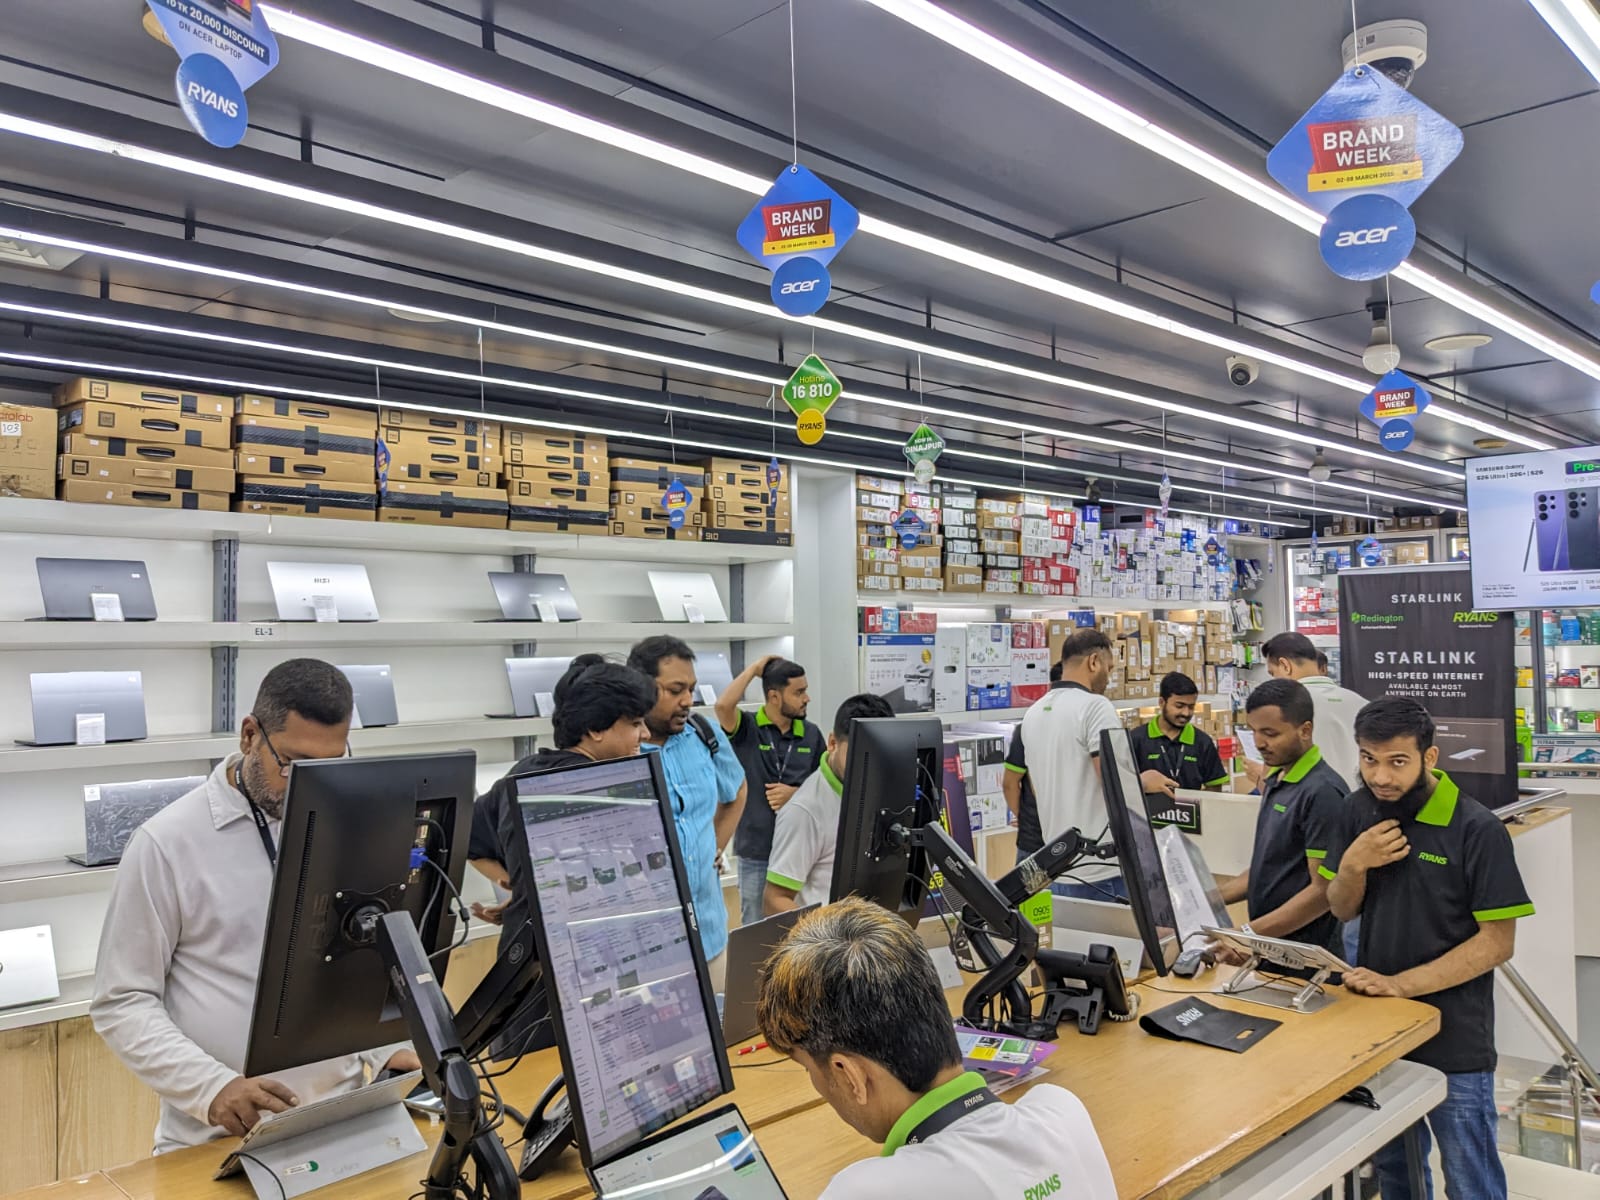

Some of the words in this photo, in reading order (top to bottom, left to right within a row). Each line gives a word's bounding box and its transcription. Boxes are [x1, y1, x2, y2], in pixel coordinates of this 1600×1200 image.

[178, 2, 189, 14] TK
[190, 6, 221, 31] 20,000
[223, 25, 265, 58] DISCOUNT
[179, 20, 191, 33] ON
[193, 28, 213, 45] ACER
[215, 40, 242, 60] LAPTOP
[187, 82, 239, 118] RYANS
[1322, 124, 1405, 151] BRAND
[1335, 146, 1392, 167] WEEK
[771, 206, 823, 226] BRAND
[780, 222, 816, 237] WEEK
[1334, 225, 1398, 247] acer
[780, 279, 820, 295] acer
[791, 385, 806, 399] 16
[809, 383, 833, 398] 810
[1379, 391, 1411, 403] BRAND
[1384, 400, 1407, 409] WEEK
[799, 422, 823, 430] RYANS
[1384, 430, 1409, 439] acer
[905, 441, 943, 453] DINAJPUR
[1391, 593, 1463, 604] STARLINK
[1360, 614, 1404, 624] Redington
[1453, 612, 1499, 623] RYANS
[1374, 651, 1476, 665] STARLINK
[1368, 671, 1429, 680] HIGH-SPEED
[1432, 672, 1485, 681] INTERNET
[1152, 809, 1191, 823] unts
[1418, 851, 1448, 865] RYANS
[963, 1093, 985, 1108] RYANS
[1023, 1173, 1062, 1200] RYANS
